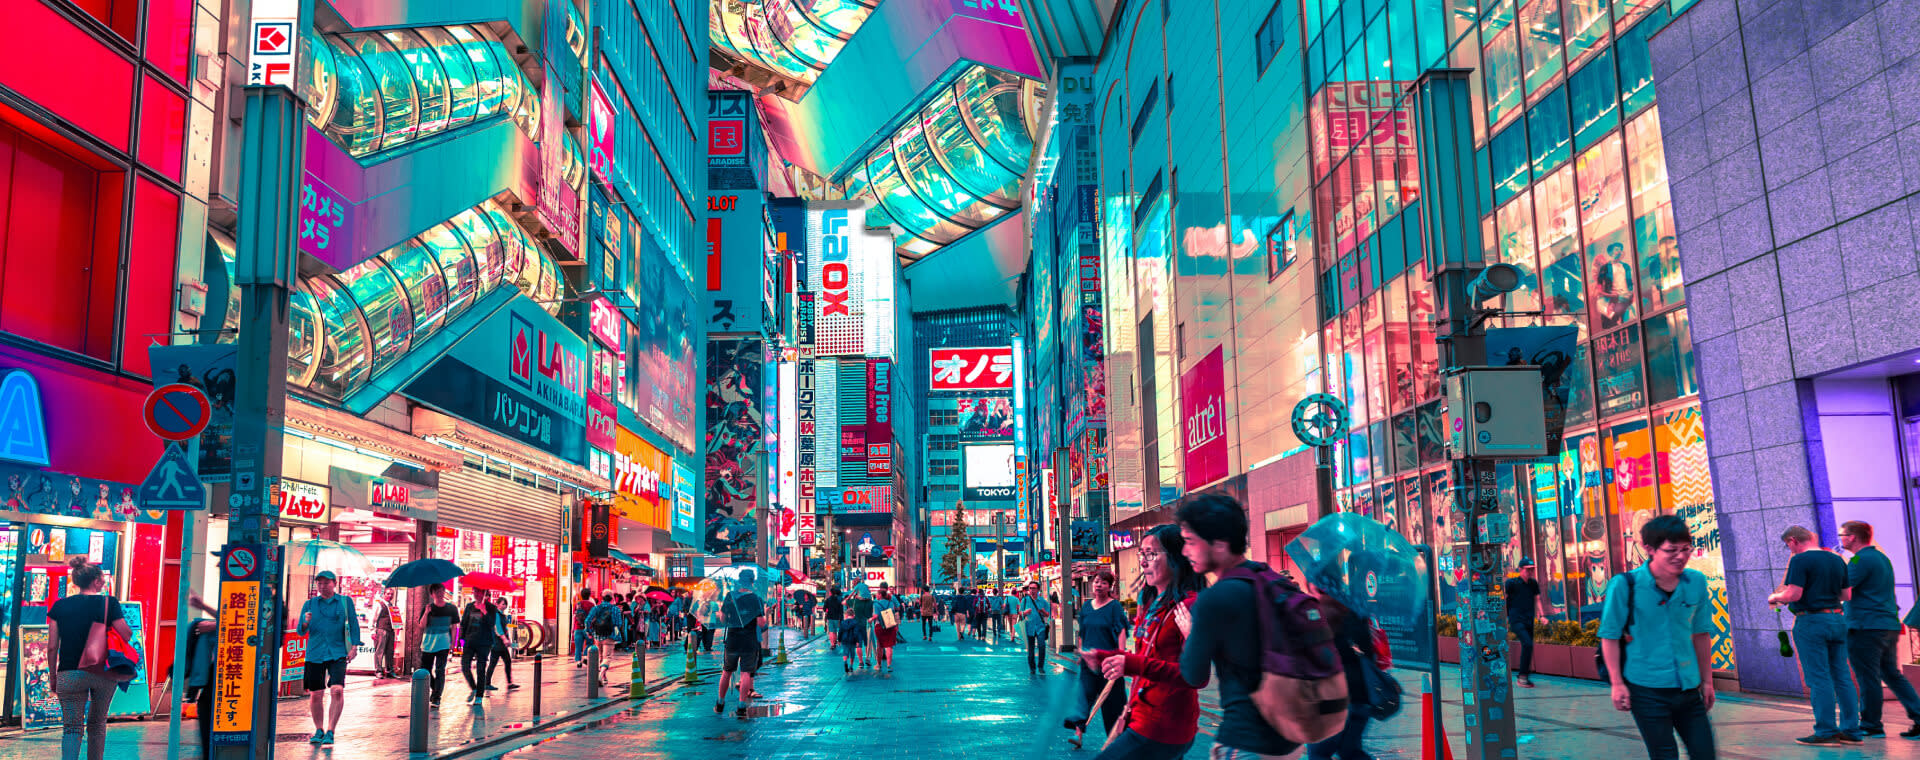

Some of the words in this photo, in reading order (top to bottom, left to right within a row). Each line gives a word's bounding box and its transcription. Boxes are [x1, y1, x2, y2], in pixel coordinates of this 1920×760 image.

[303, 184, 344, 227] カメラ
[301, 218, 329, 249] メラ
[538, 330, 584, 398] LABI
[875, 362, 889, 392] Duty
[493, 391, 551, 445] パソコン館
[536, 381, 584, 421] AKIHABARA
[875, 394, 889, 423] Free
[1188, 394, 1215, 448] atré
[385, 484, 409, 503] LABI
[976, 488, 1010, 496] TOKYO
[225, 592, 247, 727] 路上喫煙禁止です。
[287, 638, 307, 653] au
